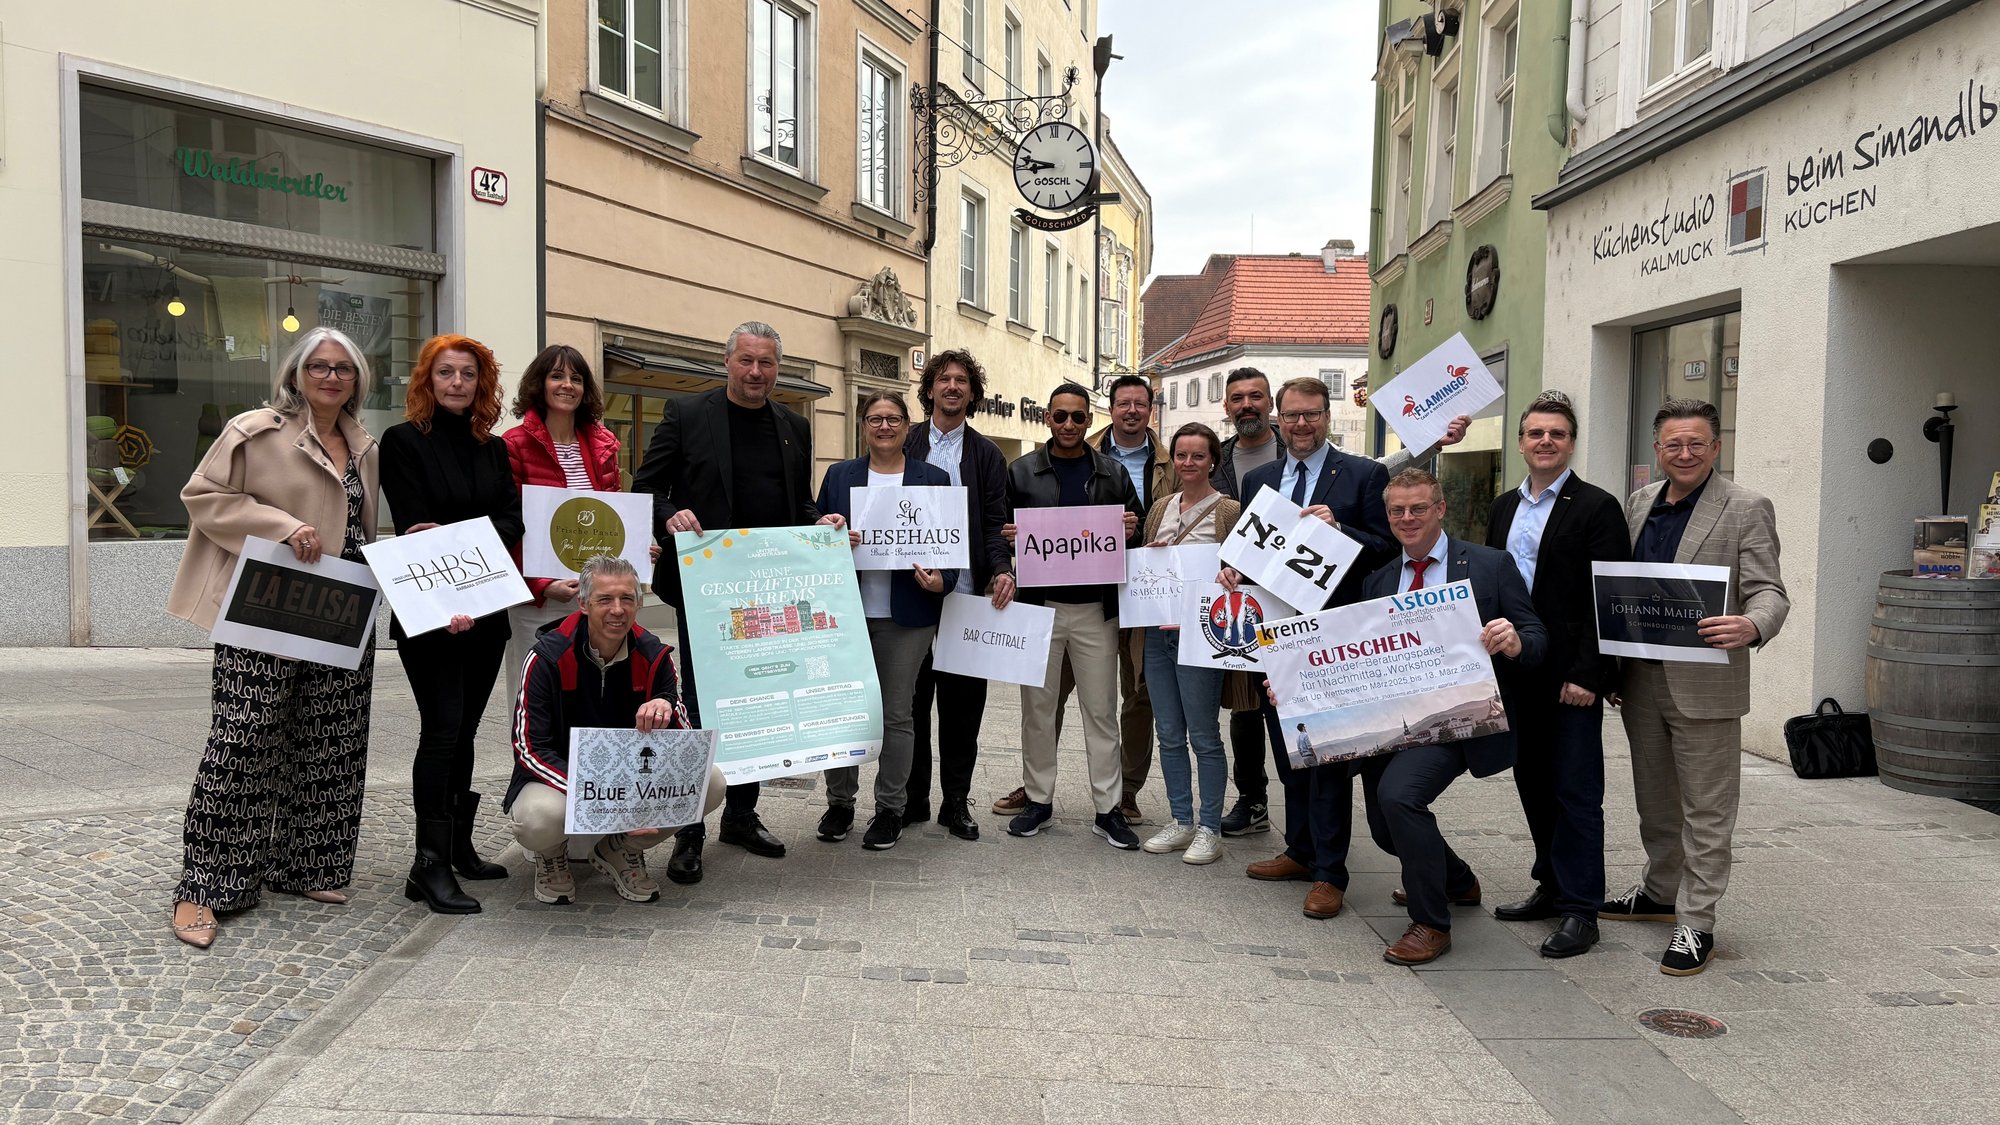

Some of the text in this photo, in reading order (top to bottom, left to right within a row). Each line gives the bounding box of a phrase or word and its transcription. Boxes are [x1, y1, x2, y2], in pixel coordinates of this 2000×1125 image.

[1787, 78, 1998, 196] beim Simandlb
[175, 146, 348, 203] Waldviertler
[480, 171, 500, 193] 47
[1034, 176, 1071, 186] GÖSCHL
[1784, 184, 1876, 233] KÜCHEN
[1025, 213, 1087, 229] GOLDSCHMIED
[1593, 193, 1714, 265] Küchenstudio
[1641, 238, 1713, 278] KALMUCK
[323, 308, 384, 326] DIE BESTEN
[1413, 375, 1467, 417] FLAMINGO
[556, 525, 619, 537] Frische Pasta
[861, 528, 960, 546] LESEHAUS
[870, 547, 890, 557] Buch
[894, 546, 926, 558] Papeterie
[930, 546, 950, 556] Wein
[1024, 529, 1117, 562] Apapika
[407, 546, 492, 592] BABSI
[750, 566, 793, 579] MEINE
[1284, 543, 1338, 591] 21
[700, 573, 845, 596] GESCHÄFTSIDEE
[1130, 586, 1174, 597] ISABELLA
[245, 571, 282, 608] LA
[284, 581, 361, 625] ELISA
[735, 587, 816, 608] IN KREMS
[1389, 603, 1456, 621] Wirtschaftsberatung
[1391, 613, 1435, 628] mit Weitblick
[1611, 602, 1704, 619] JOHANN MAIER
[1260, 618, 1320, 641] krems
[1628, 620, 1686, 631] SCHUHBOUTIQUE
[963, 627, 1027, 650] BAR CENTRALE
[1266, 644, 1279, 654] So
[1280, 639, 1296, 651] viel
[1308, 630, 1422, 667] GUTSCHEIN
[1222, 660, 1247, 670] Krems
[1302, 680, 1317, 691] für
[1322, 667, 1382, 689] Nachmittag
[1323, 683, 1368, 699] Wettbewerb
[1410, 673, 1422, 682] bis
[1424, 671, 1437, 680] 13.
[1439, 666, 1458, 678] März
[1460, 662, 1481, 673] 2026
[805, 687, 826, 695] UNSER
[734, 729, 765, 738] BEWIRBST
[584, 781, 696, 801] BLUE VANILLA
